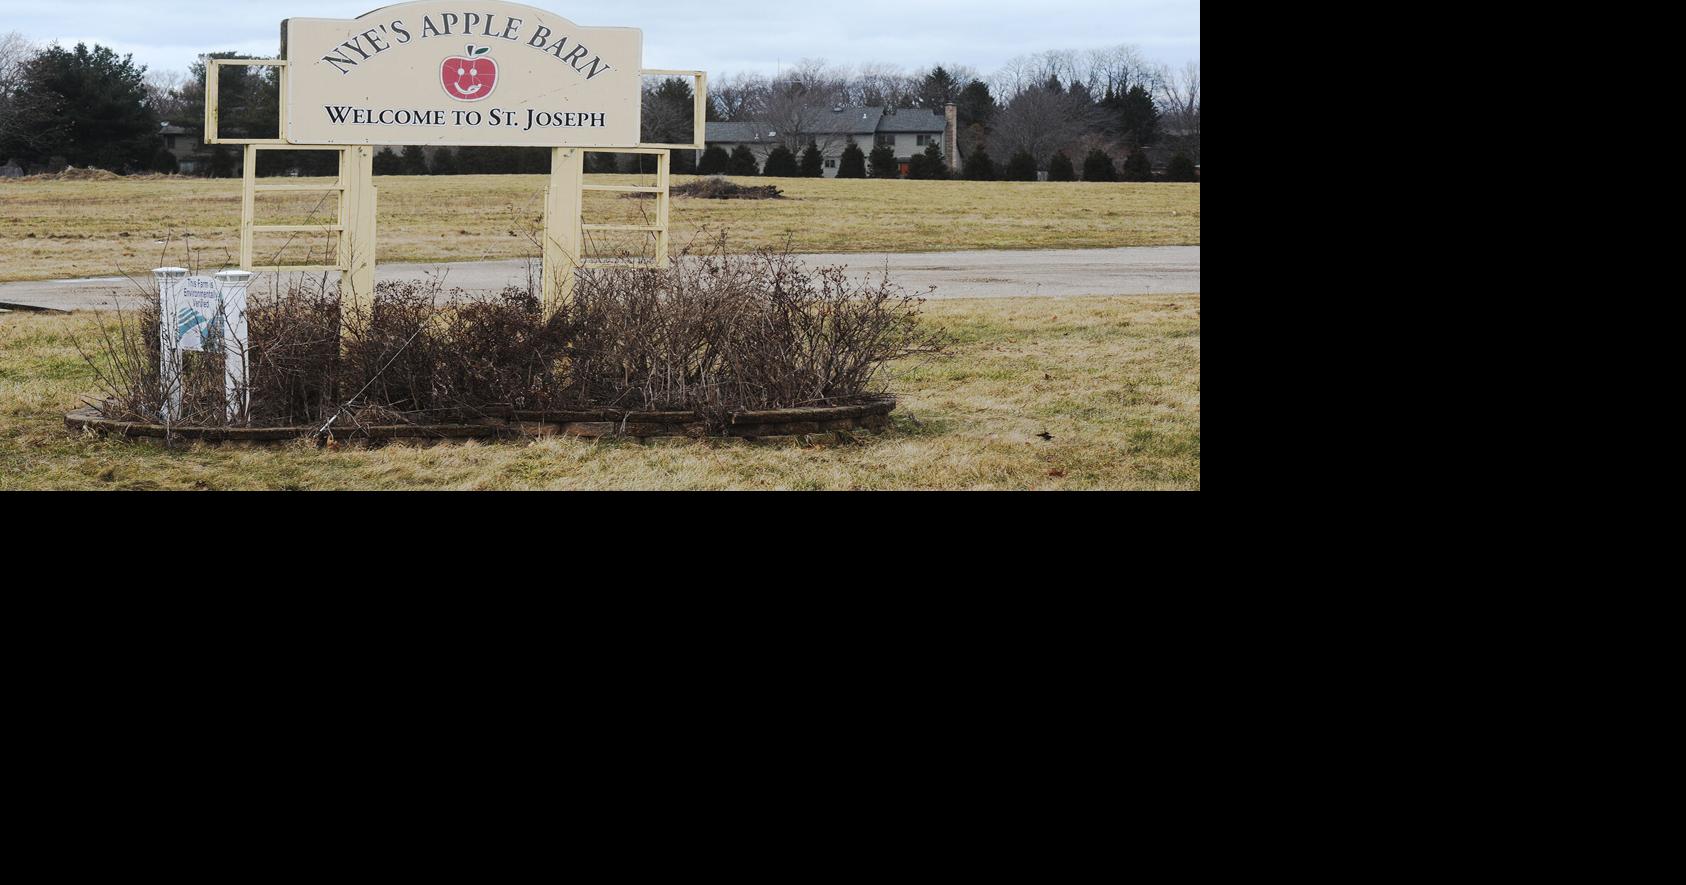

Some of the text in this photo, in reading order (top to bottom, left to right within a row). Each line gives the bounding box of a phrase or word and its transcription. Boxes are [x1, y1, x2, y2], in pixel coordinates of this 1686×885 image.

[321, 12, 611, 80] NYE'S APPLE BARN
[325, 106, 446, 126] WELCOME
[452, 109, 481, 126] TO
[524, 109, 606, 130] JOSEPH
